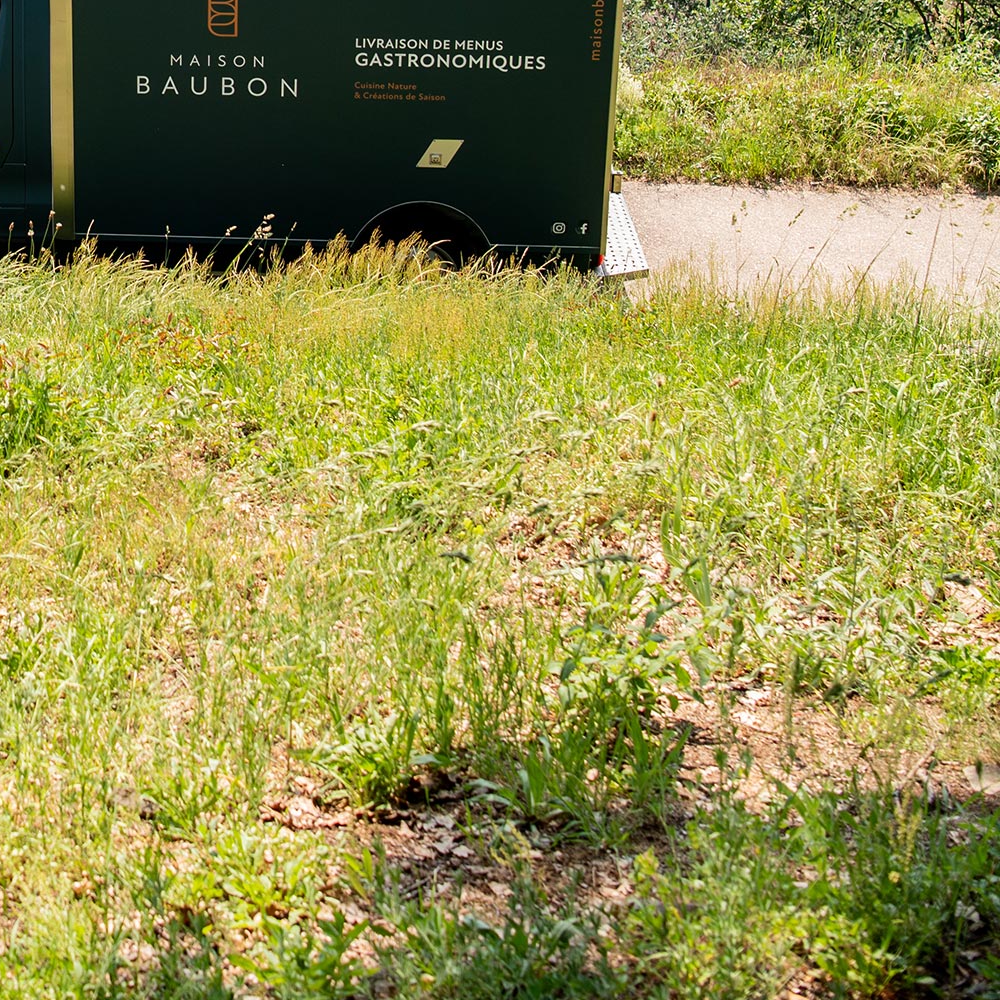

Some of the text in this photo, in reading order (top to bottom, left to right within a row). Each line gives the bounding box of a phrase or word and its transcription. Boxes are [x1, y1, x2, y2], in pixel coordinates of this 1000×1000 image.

[355, 38, 504, 50] LIVRAISON DE MENUS
[170, 54, 265, 68] MAISON
[355, 53, 547, 72] GASTRONOMIQUES
[136, 75, 298, 98] BAUBON
[354, 81, 417, 91] Cuisine Nature
[354, 91, 446, 102] & Créations de Saison
